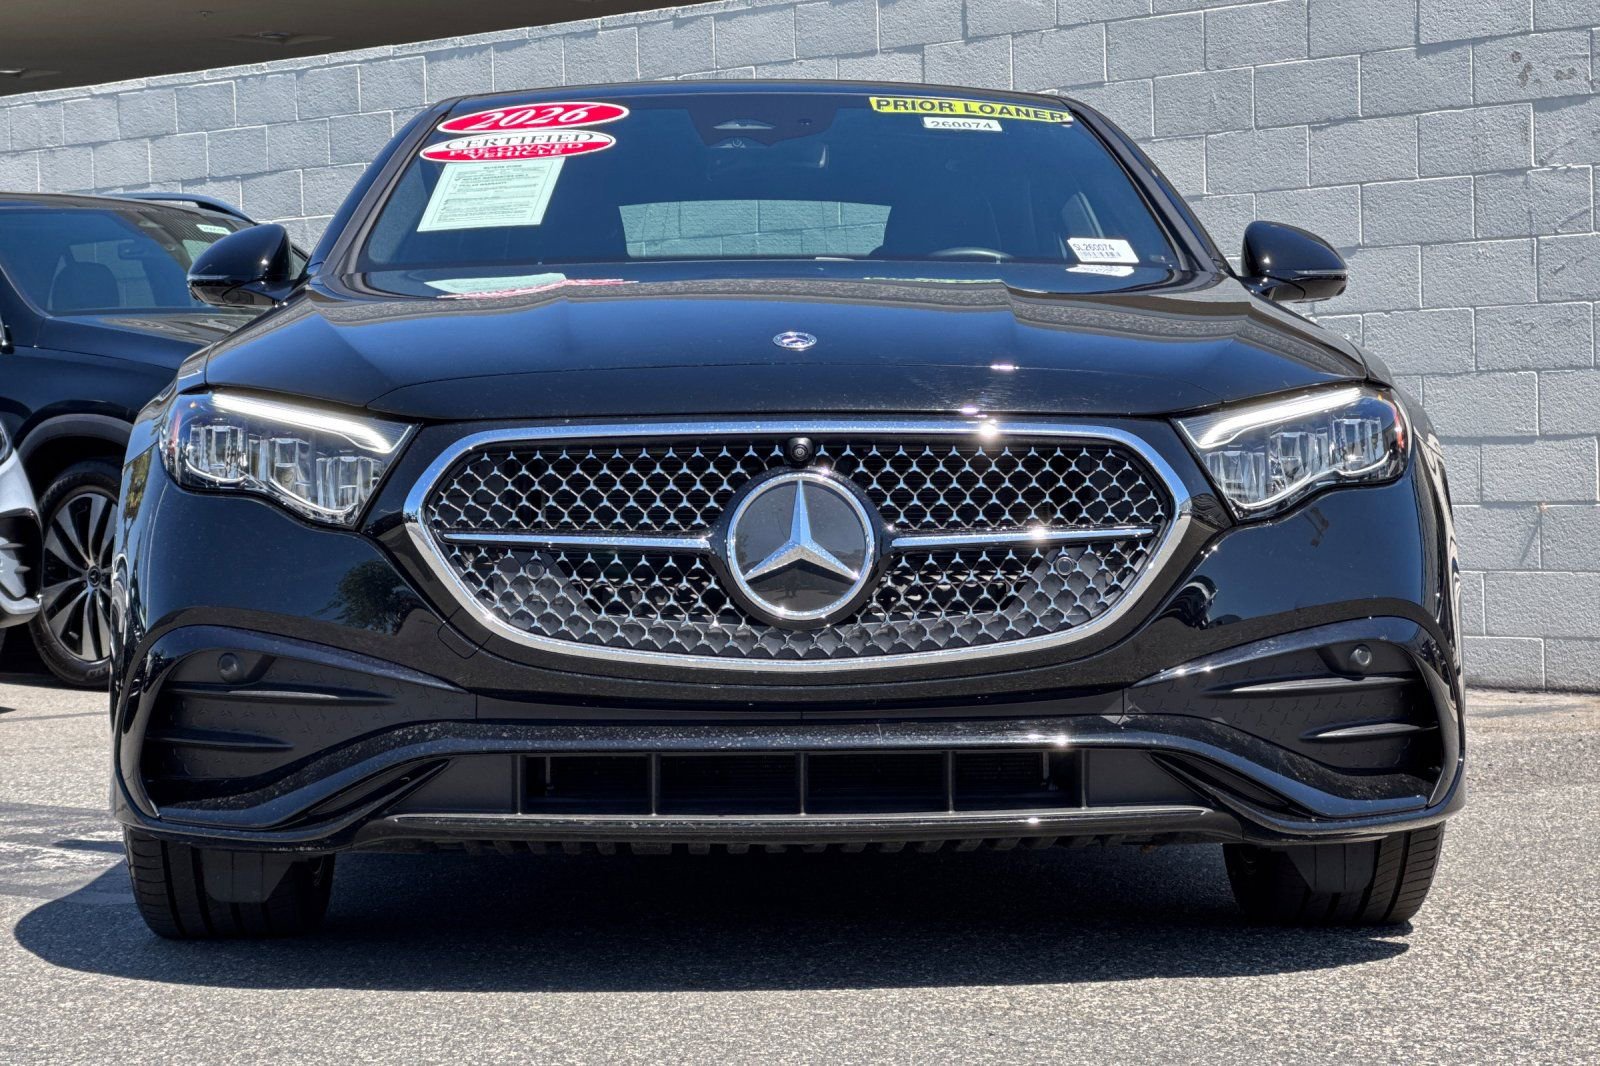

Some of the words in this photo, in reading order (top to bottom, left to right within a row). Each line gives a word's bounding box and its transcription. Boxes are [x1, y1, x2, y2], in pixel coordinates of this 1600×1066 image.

[463, 104, 601, 130] 2026
[876, 99, 956, 113] PRIOR
[964, 102, 1064, 121] LOANER
[930, 120, 992, 129] 260074
[445, 133, 594, 149] CERTIFIED
[449, 143, 584, 156] PRE-OWNED
[470, 148, 562, 159] VEHICLE
